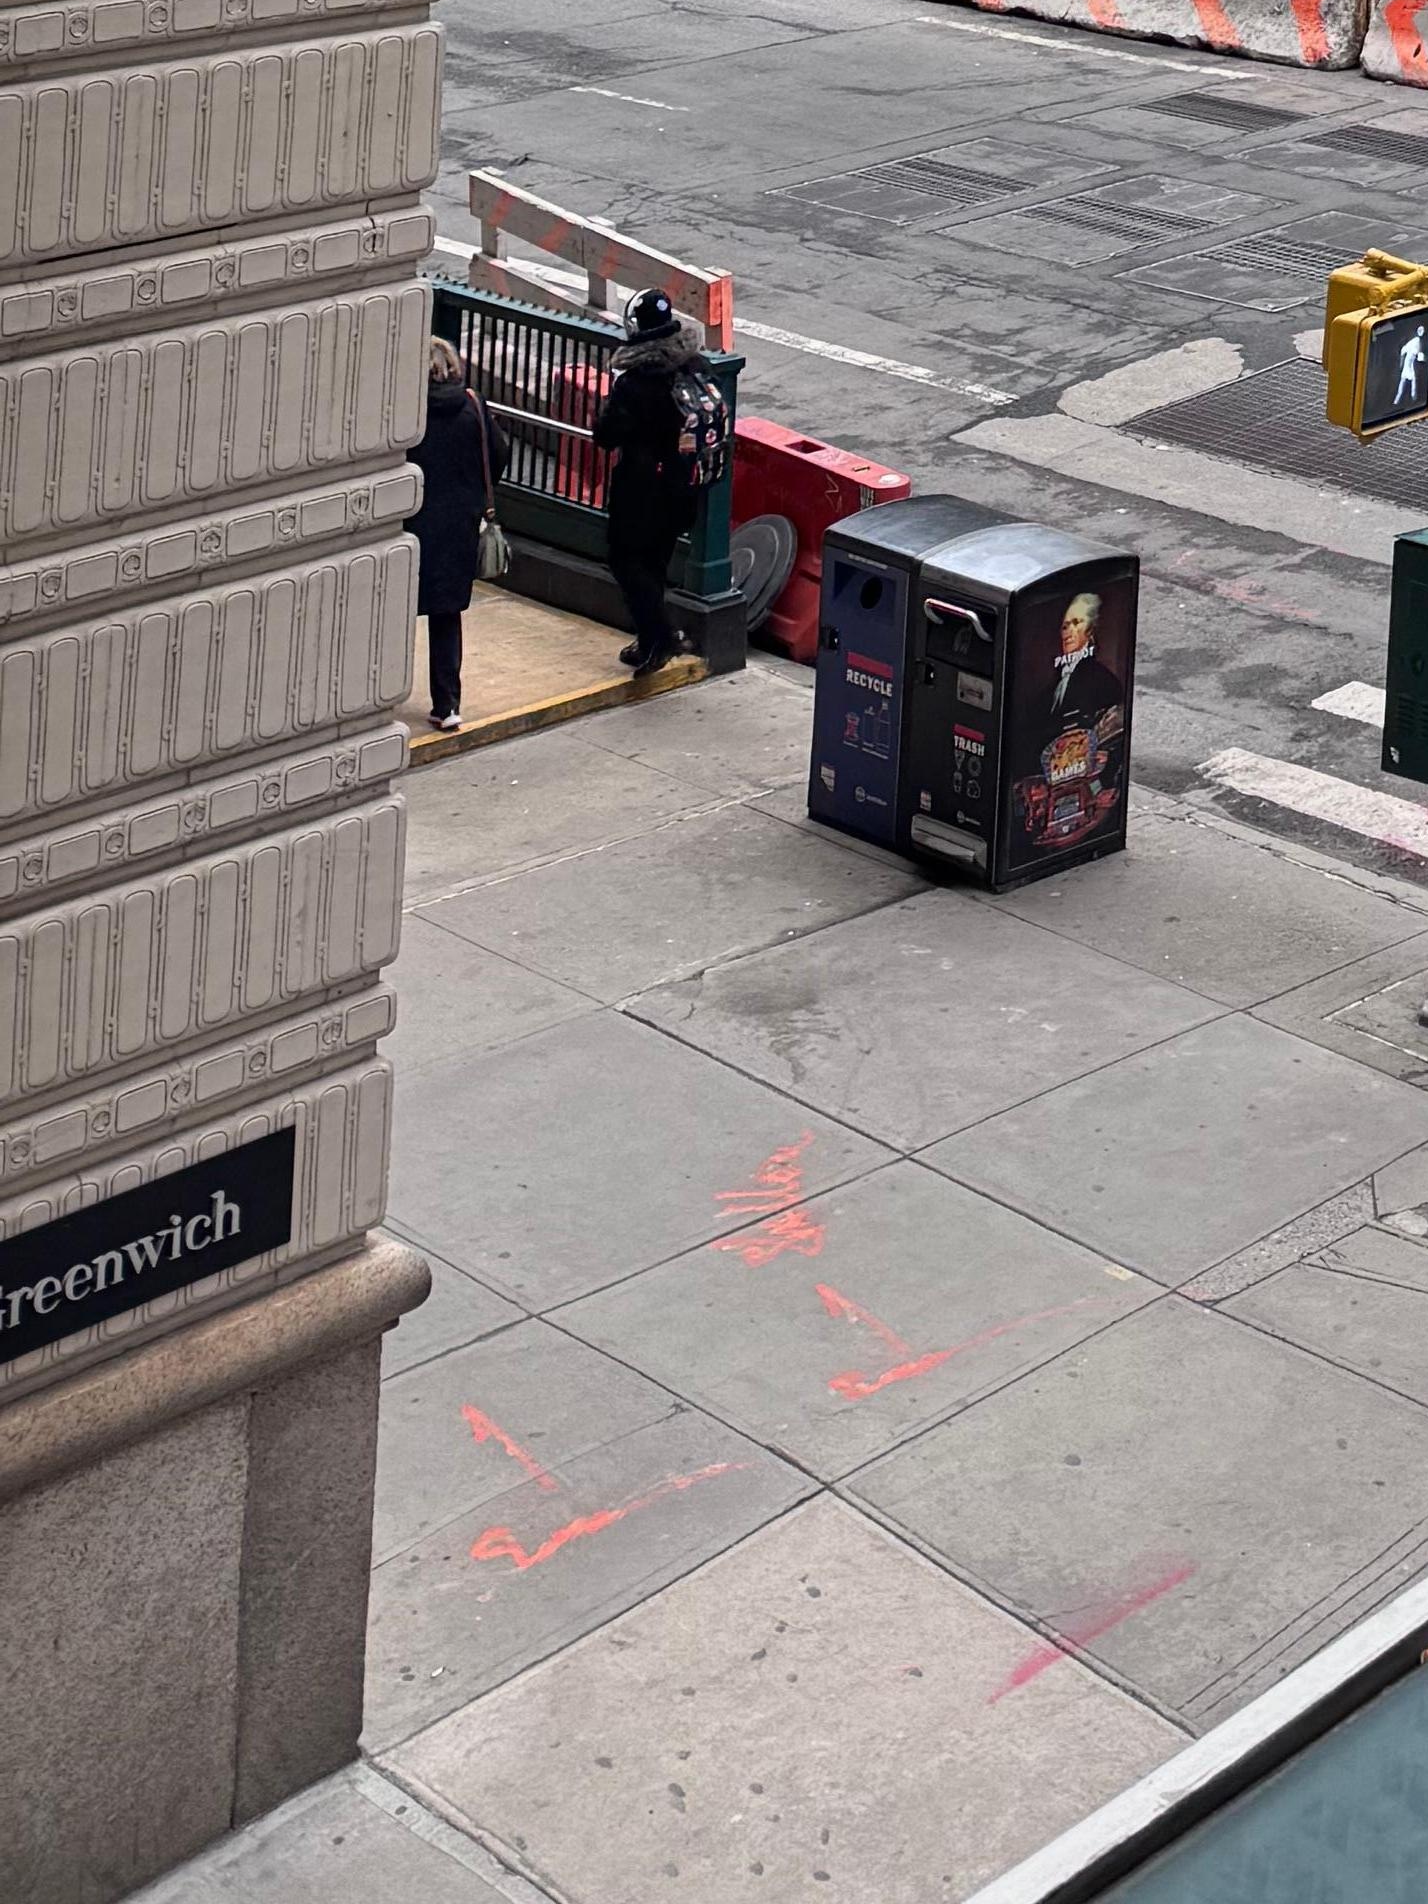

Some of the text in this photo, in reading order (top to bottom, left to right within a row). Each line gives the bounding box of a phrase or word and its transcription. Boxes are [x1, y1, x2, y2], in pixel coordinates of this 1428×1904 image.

[846, 669, 893, 697] RECYCLE
[954, 735, 985, 757] TRASH
[0, 1190, 241, 1330] reenwich
